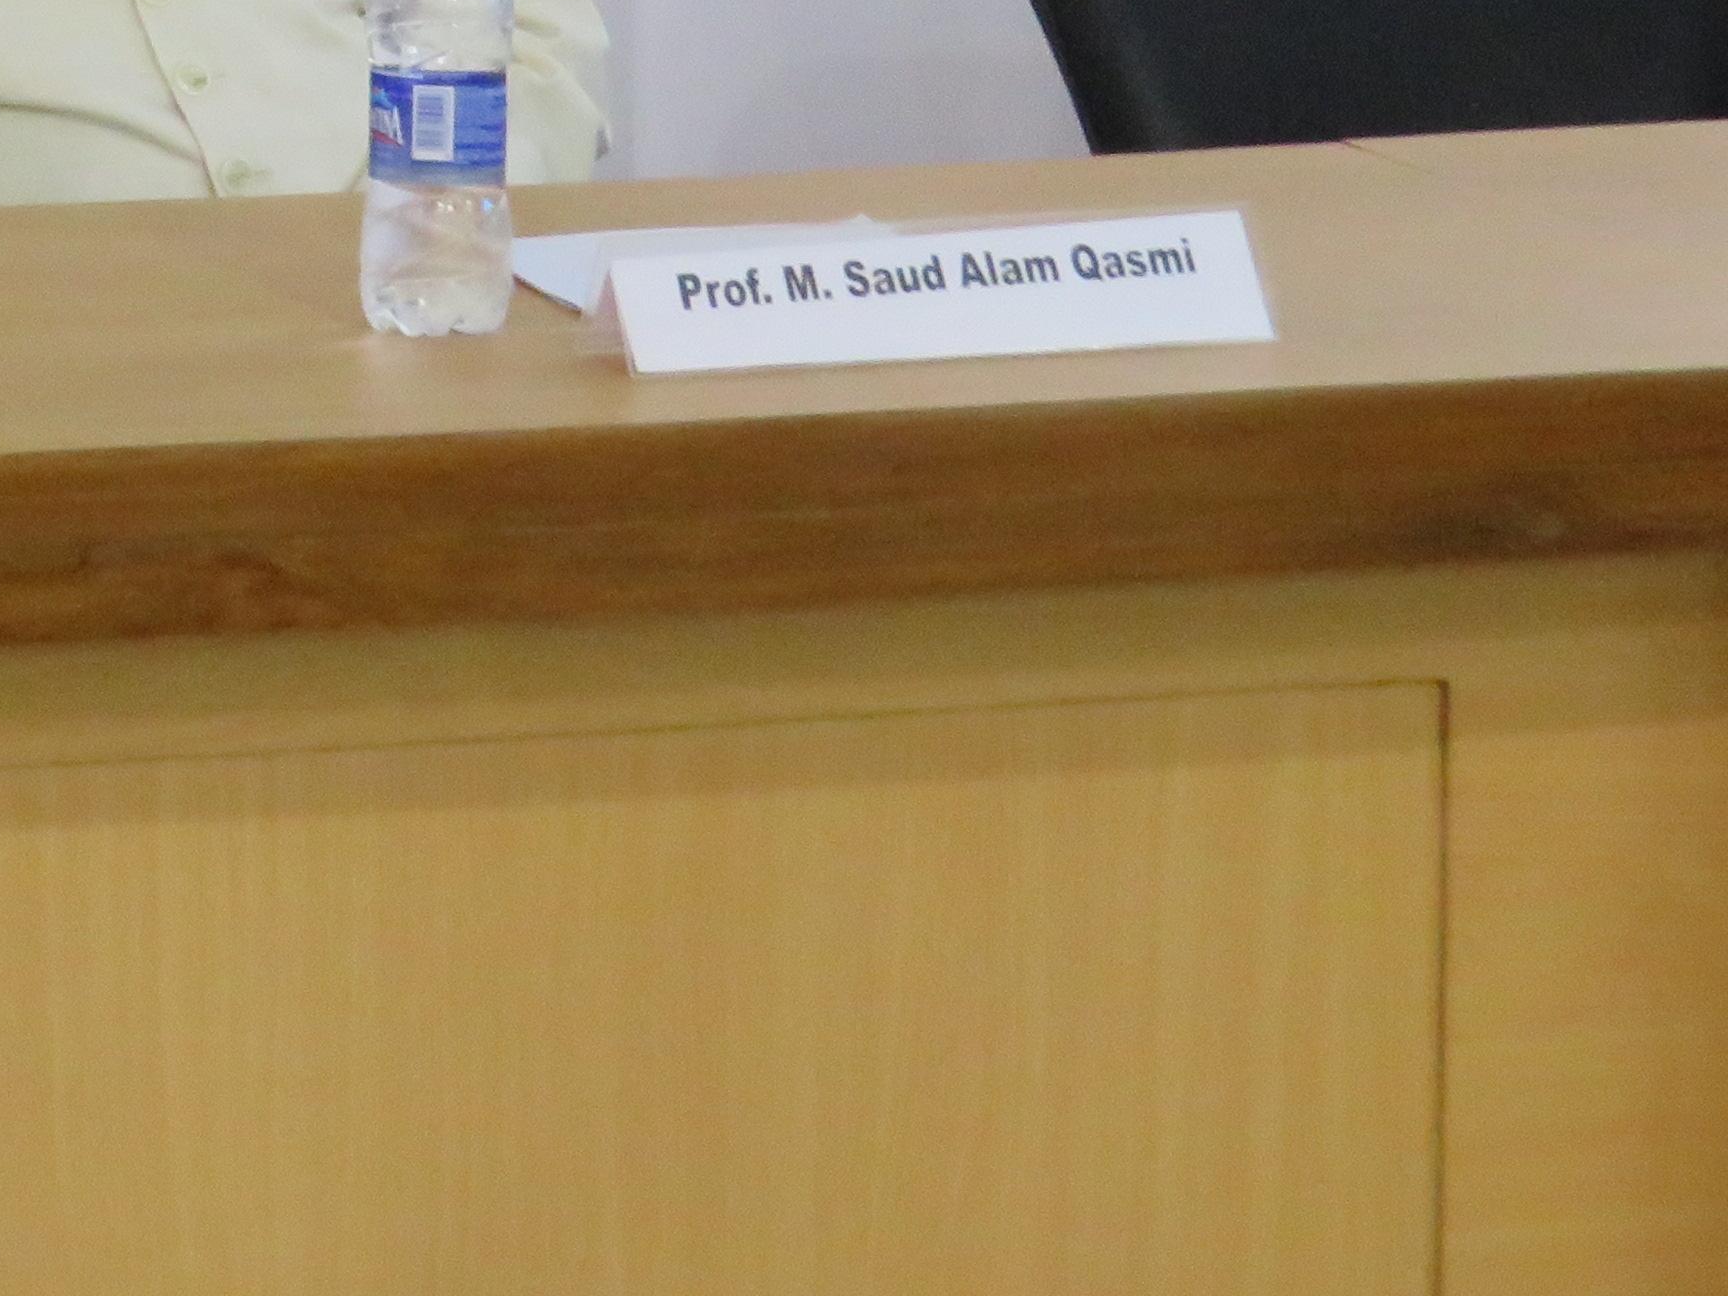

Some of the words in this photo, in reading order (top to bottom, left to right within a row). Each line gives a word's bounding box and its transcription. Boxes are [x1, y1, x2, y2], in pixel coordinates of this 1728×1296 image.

[676, 271, 774, 311] Prof.
[783, 263, 833, 303] M.
[843, 255, 947, 298] Saud
[959, 251, 1060, 289] Alam
[1071, 237, 1199, 283] Qasmi
